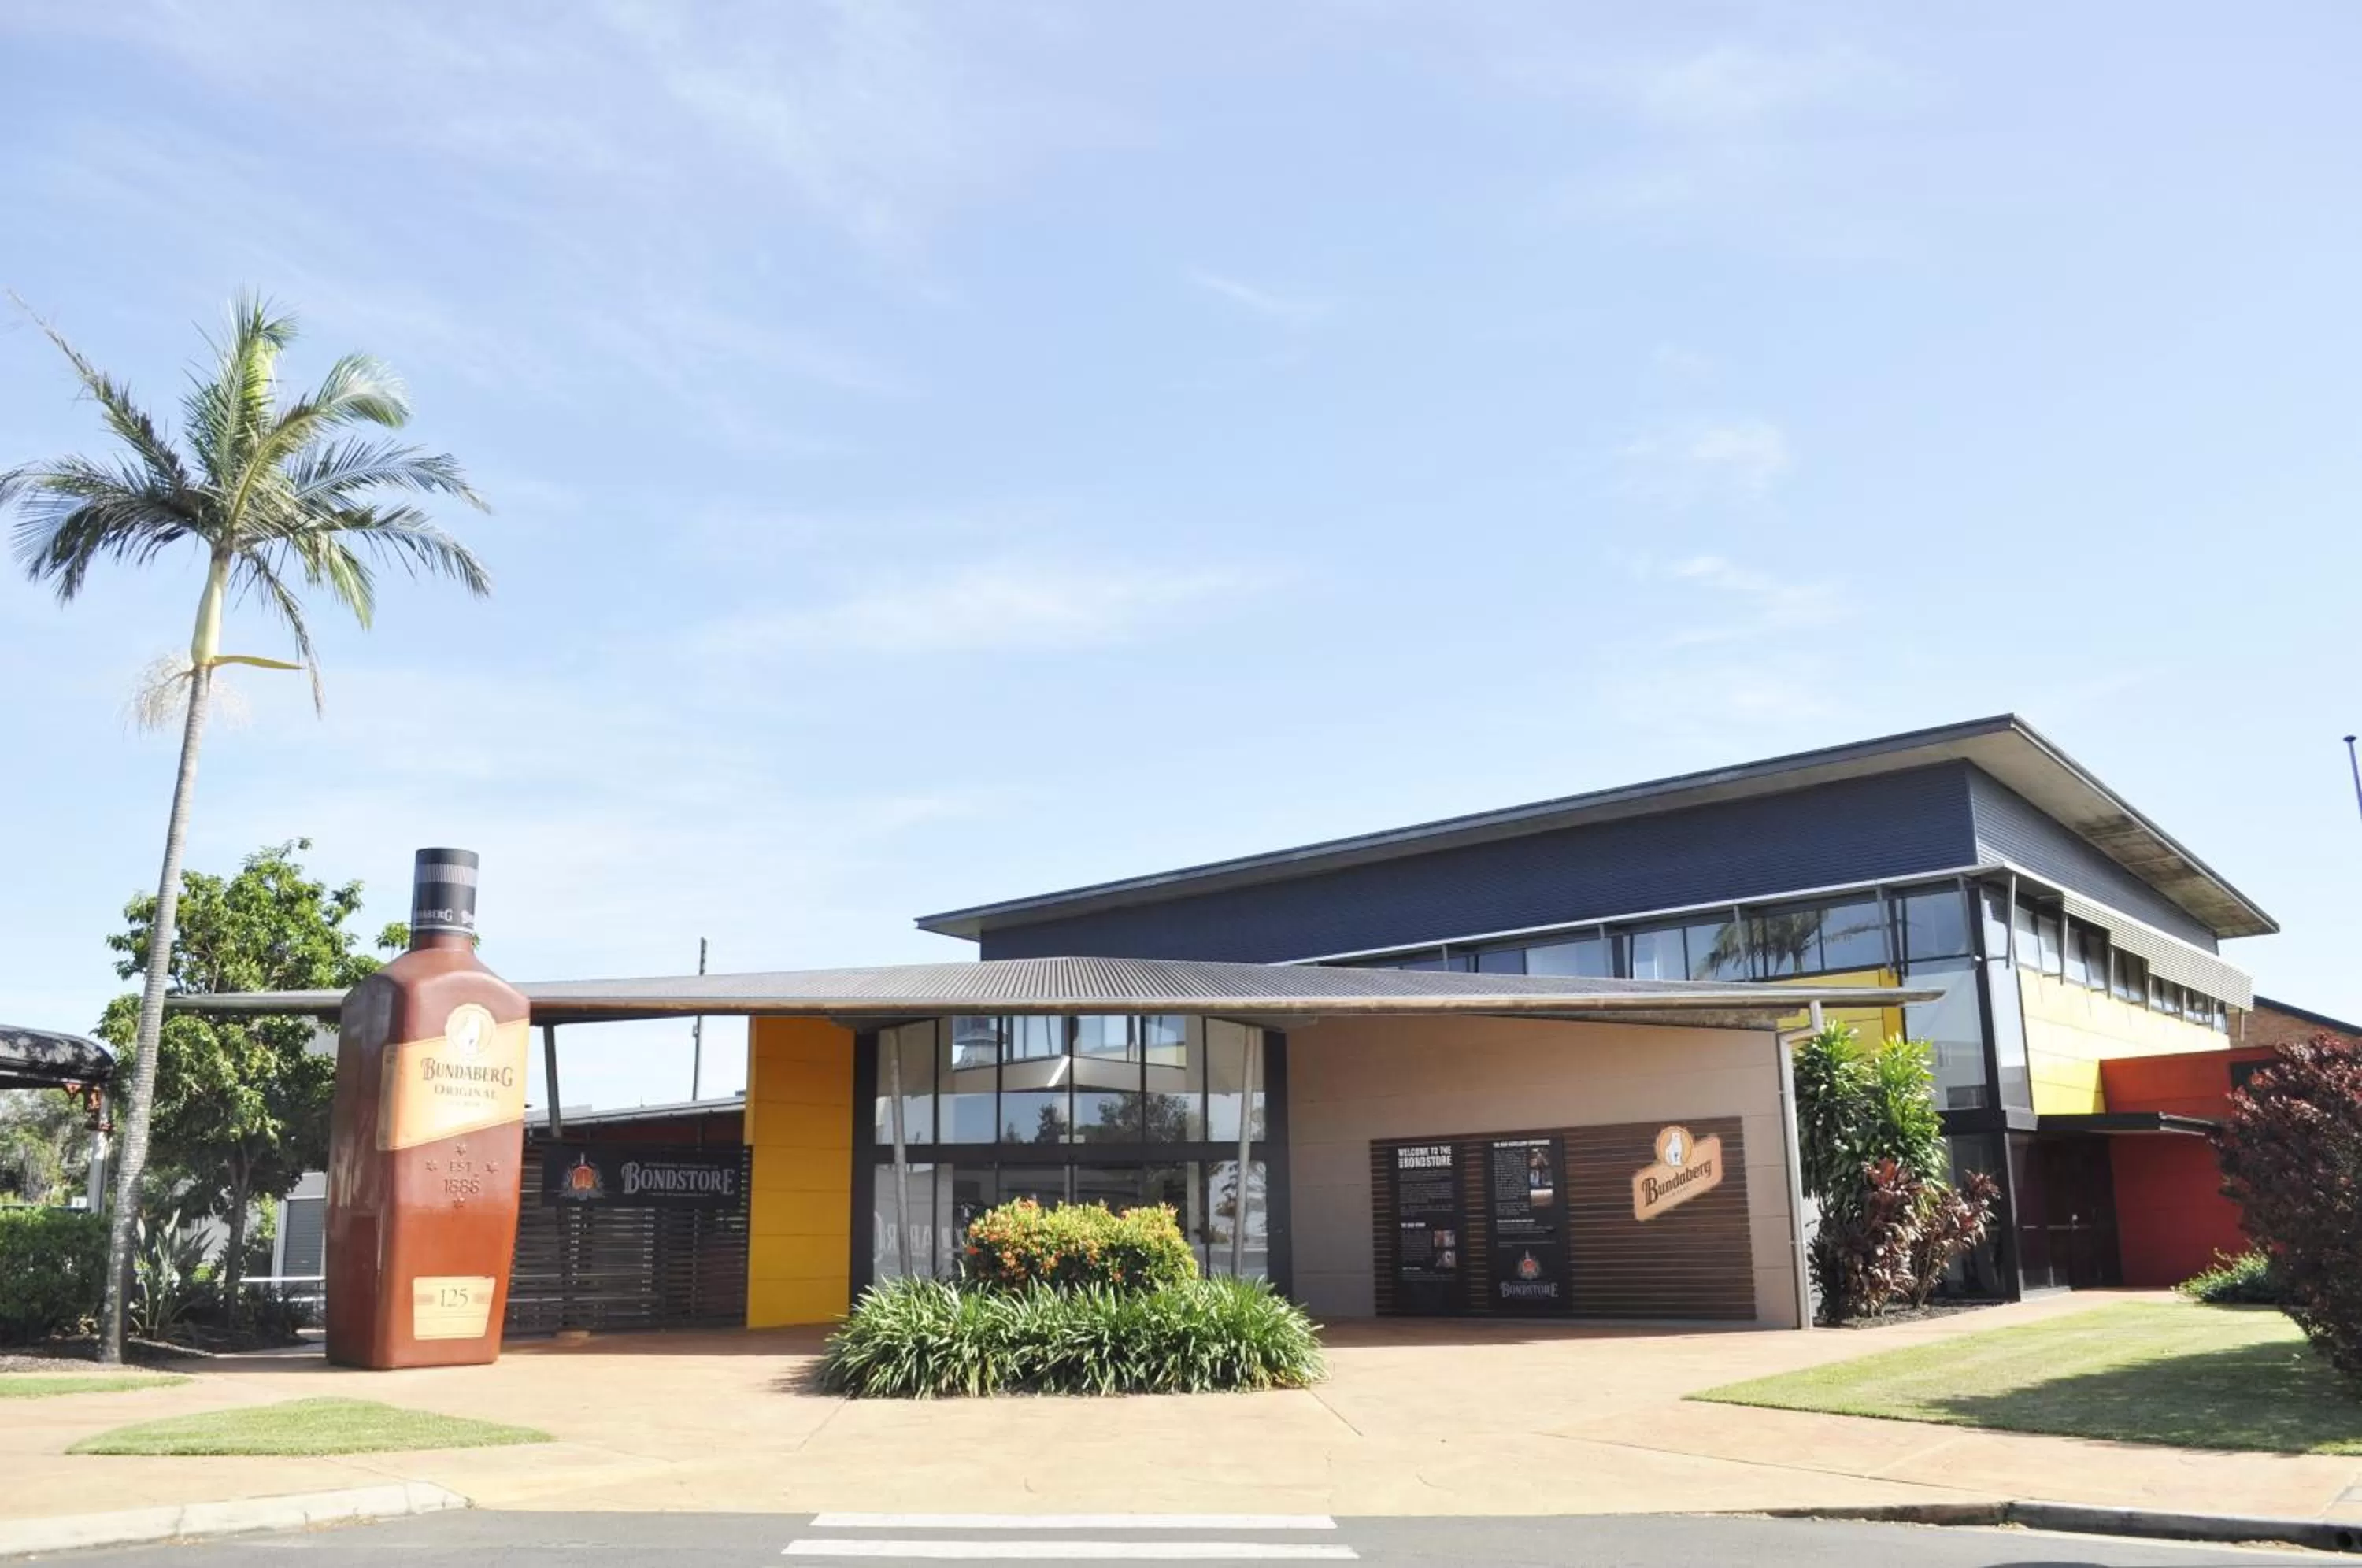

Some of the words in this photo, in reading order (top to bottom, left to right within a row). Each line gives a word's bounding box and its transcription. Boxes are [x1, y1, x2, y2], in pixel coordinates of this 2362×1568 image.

[420, 1057, 513, 1087] BUNDABERG
[434, 1083, 498, 1100] ORIGINAL
[1398, 1147, 1429, 1156] WELCOME
[1404, 1155, 1453, 1168] BONDSTORE
[443, 1178, 479, 1195] 1888
[621, 1161, 735, 1195] BONDSTORE
[1642, 1160, 1712, 1207] Bundaberg
[440, 1288, 469, 1308] 125
